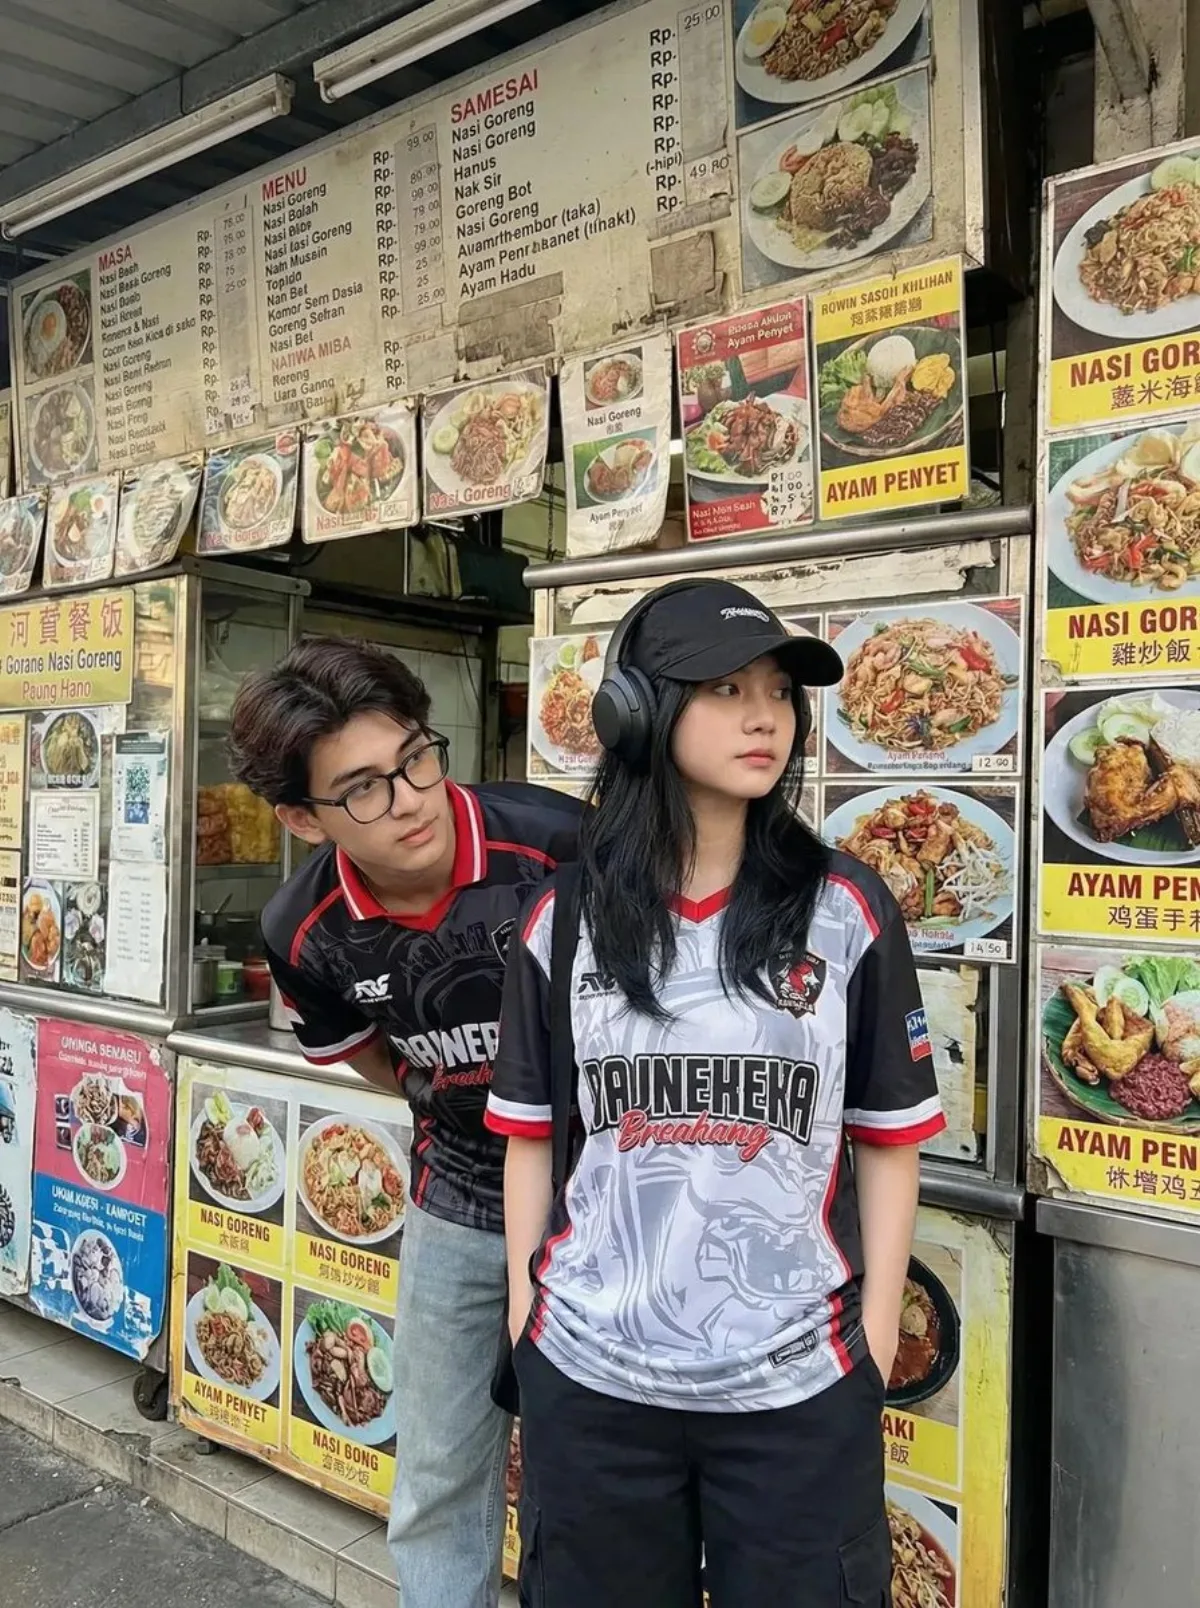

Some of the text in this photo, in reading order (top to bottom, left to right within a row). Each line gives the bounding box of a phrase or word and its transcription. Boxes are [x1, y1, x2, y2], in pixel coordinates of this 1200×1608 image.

[451, 68, 538, 124] SAMESAI
[452, 100, 535, 144] Nasi Goreng
[453, 120, 536, 163] Nasi Goreng
[262, 166, 307, 202] MENU
[454, 156, 497, 183] Hanus
[263, 183, 327, 217] Nasi Goreng
[455, 181, 480, 202] Nak
[456, 180, 533, 220] Goreng Bot
[263, 212, 287, 233] Nasi
[457, 200, 540, 240] Nasi Goreng
[264, 228, 287, 248] Nasi
[264, 243, 288, 264] Nasi
[311, 221, 353, 245] Goreng
[98, 244, 133, 274] MASA
[459, 256, 496, 279] Ayam
[460, 263, 537, 298] Ayam Hadu
[821, 297, 858, 317] ROWIN
[268, 317, 308, 338] Goreng
[727, 333, 756, 350] Ayam
[270, 335, 293, 354] Nasi
[1071, 340, 1200, 388] NASI GOR
[587, 405, 642, 428] Nasi Goreng
[463, 481, 512, 503] Goreng
[826, 476, 877, 504] AYAM
[884, 461, 960, 494] PENYET
[1069, 606, 1197, 639] NASI GOR
[48, 648, 74, 672] Nasi
[77, 648, 123, 672] Goreng
[1067, 872, 1142, 899] AYAM
[1057, 1126, 1198, 1172] AYAM PEN
[200, 1207, 224, 1229] NASI
[227, 1215, 271, 1243] GORENG
[309, 1240, 337, 1264] NASI
[340, 1249, 392, 1280] GORENG
[194, 1379, 223, 1405] AYAM
[225, 1392, 268, 1424] PENYET
[312, 1429, 341, 1456] NASI
